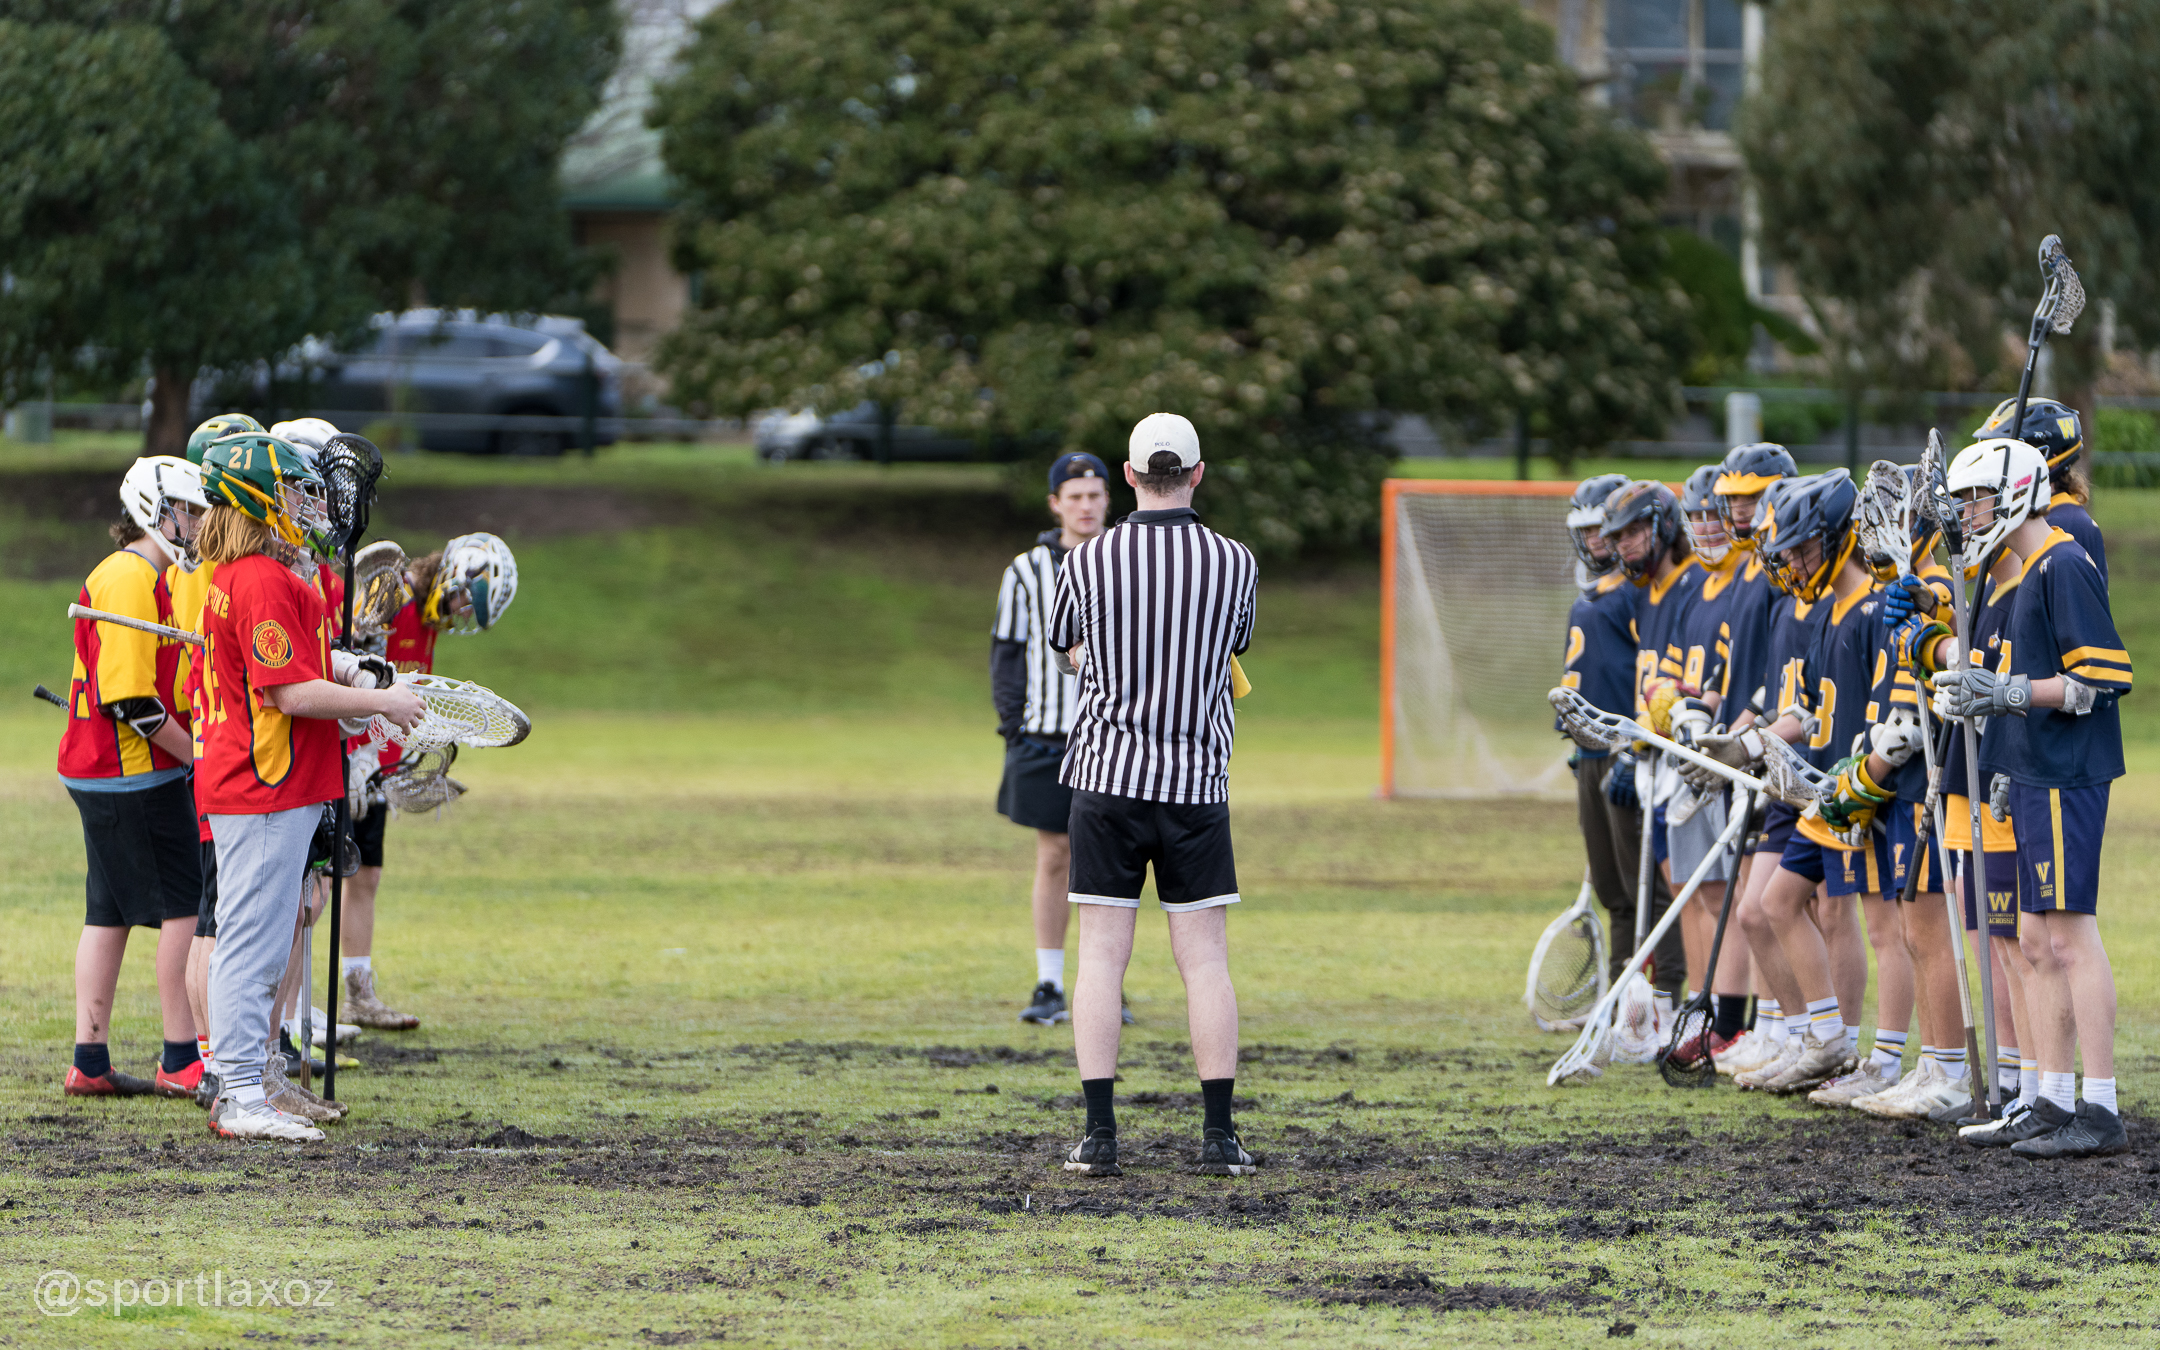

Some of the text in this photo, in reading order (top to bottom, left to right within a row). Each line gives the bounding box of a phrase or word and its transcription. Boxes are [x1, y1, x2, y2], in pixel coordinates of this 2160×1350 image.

[2056, 417, 2075, 440] W
[228, 446, 253, 470] 21
[1809, 676, 1837, 750] 3
[1987, 891, 2013, 912] W
